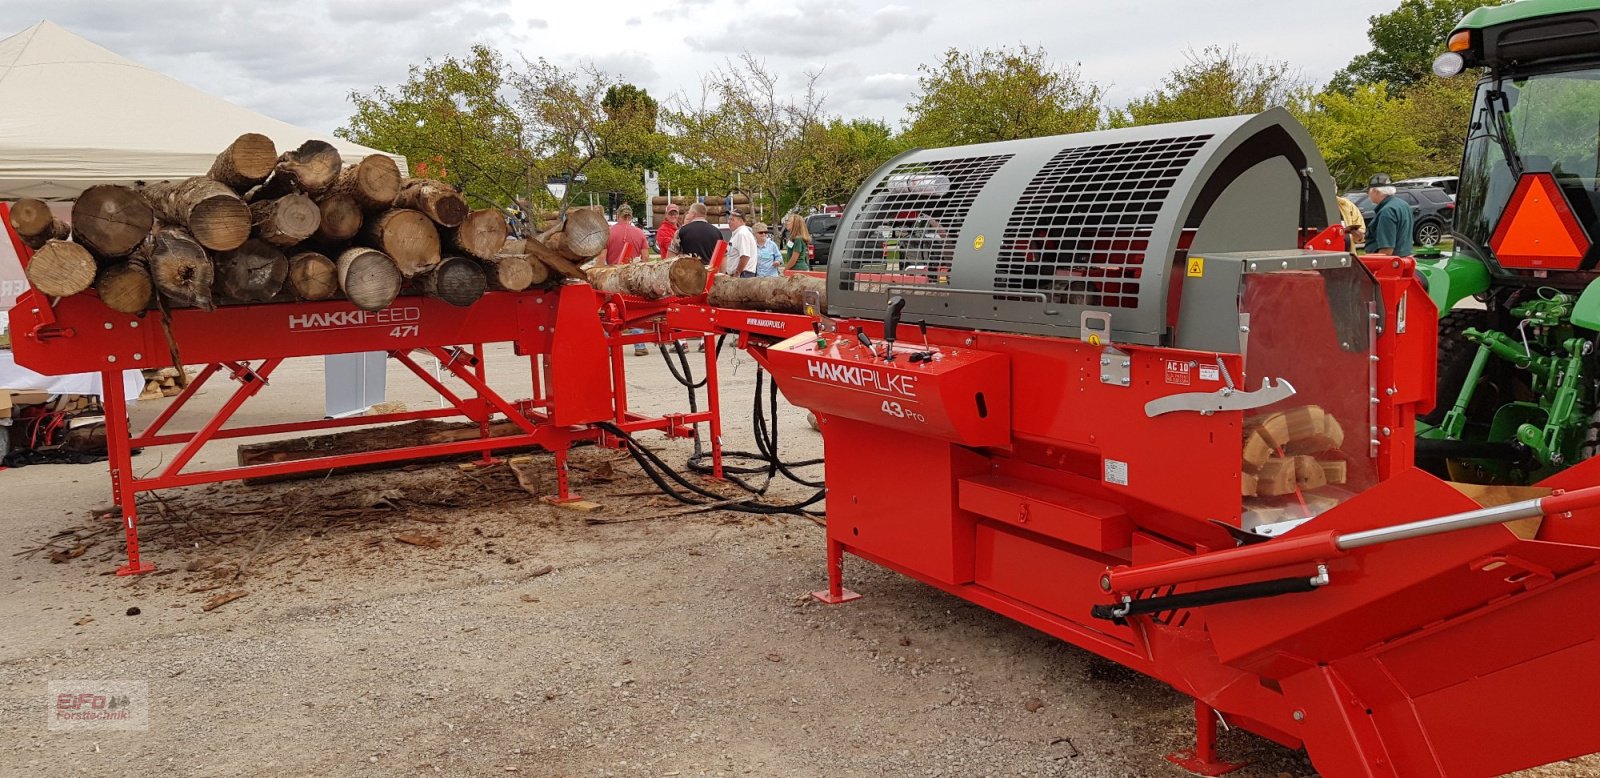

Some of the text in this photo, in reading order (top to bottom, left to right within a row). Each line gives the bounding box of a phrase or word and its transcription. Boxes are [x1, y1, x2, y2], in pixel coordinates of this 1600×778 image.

[288, 306, 421, 329] HAKKIFEED
[389, 325, 419, 338] 471
[807, 359, 917, 397] HAKKIPILKE
[1167, 361, 1189, 372] AC 10
[881, 400, 926, 424] 43 Pro
